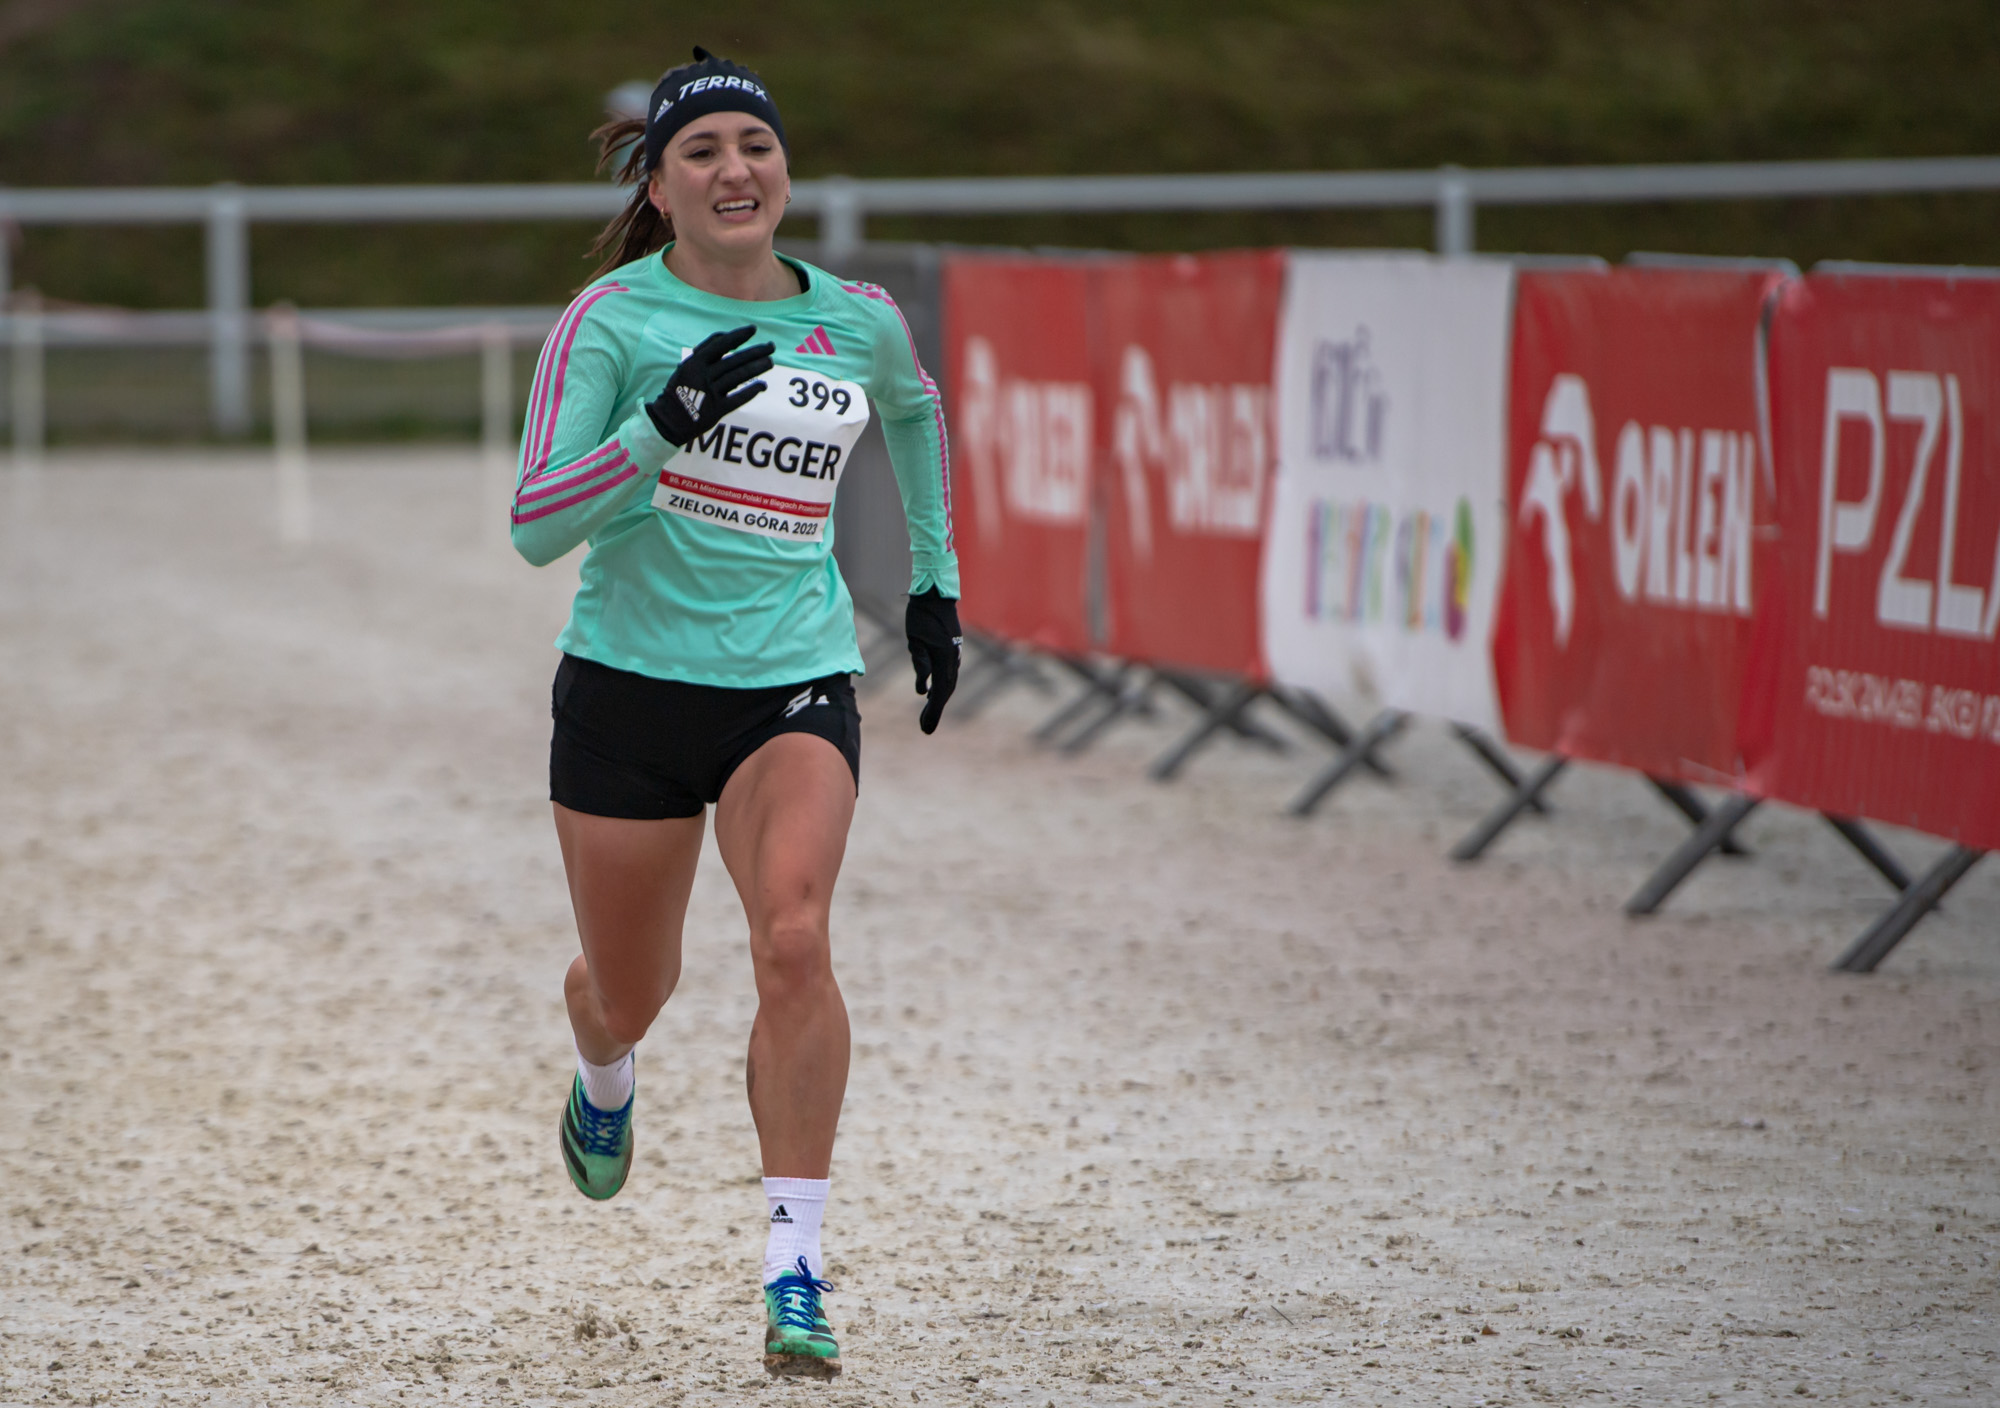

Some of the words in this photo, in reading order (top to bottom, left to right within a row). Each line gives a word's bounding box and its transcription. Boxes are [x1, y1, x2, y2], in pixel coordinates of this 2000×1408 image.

[678, 75, 768, 102] TERREX
[675, 385, 701, 421] adidas
[788, 376, 852, 416] 399
[684, 422, 842, 480] MEGGER
[668, 493, 739, 524] ZIELONA
[744, 511, 790, 533] GÓRA
[792, 521, 818, 535] 2023
[681, 479, 699, 489] PZLA
[699, 484, 742, 499] Mistrzostwa
[742, 493, 763, 503] Polski
[769, 498, 798, 510] Biegach
[1812, 366, 2000, 642] PZL
[1610, 418, 1755, 618] ORLEN
